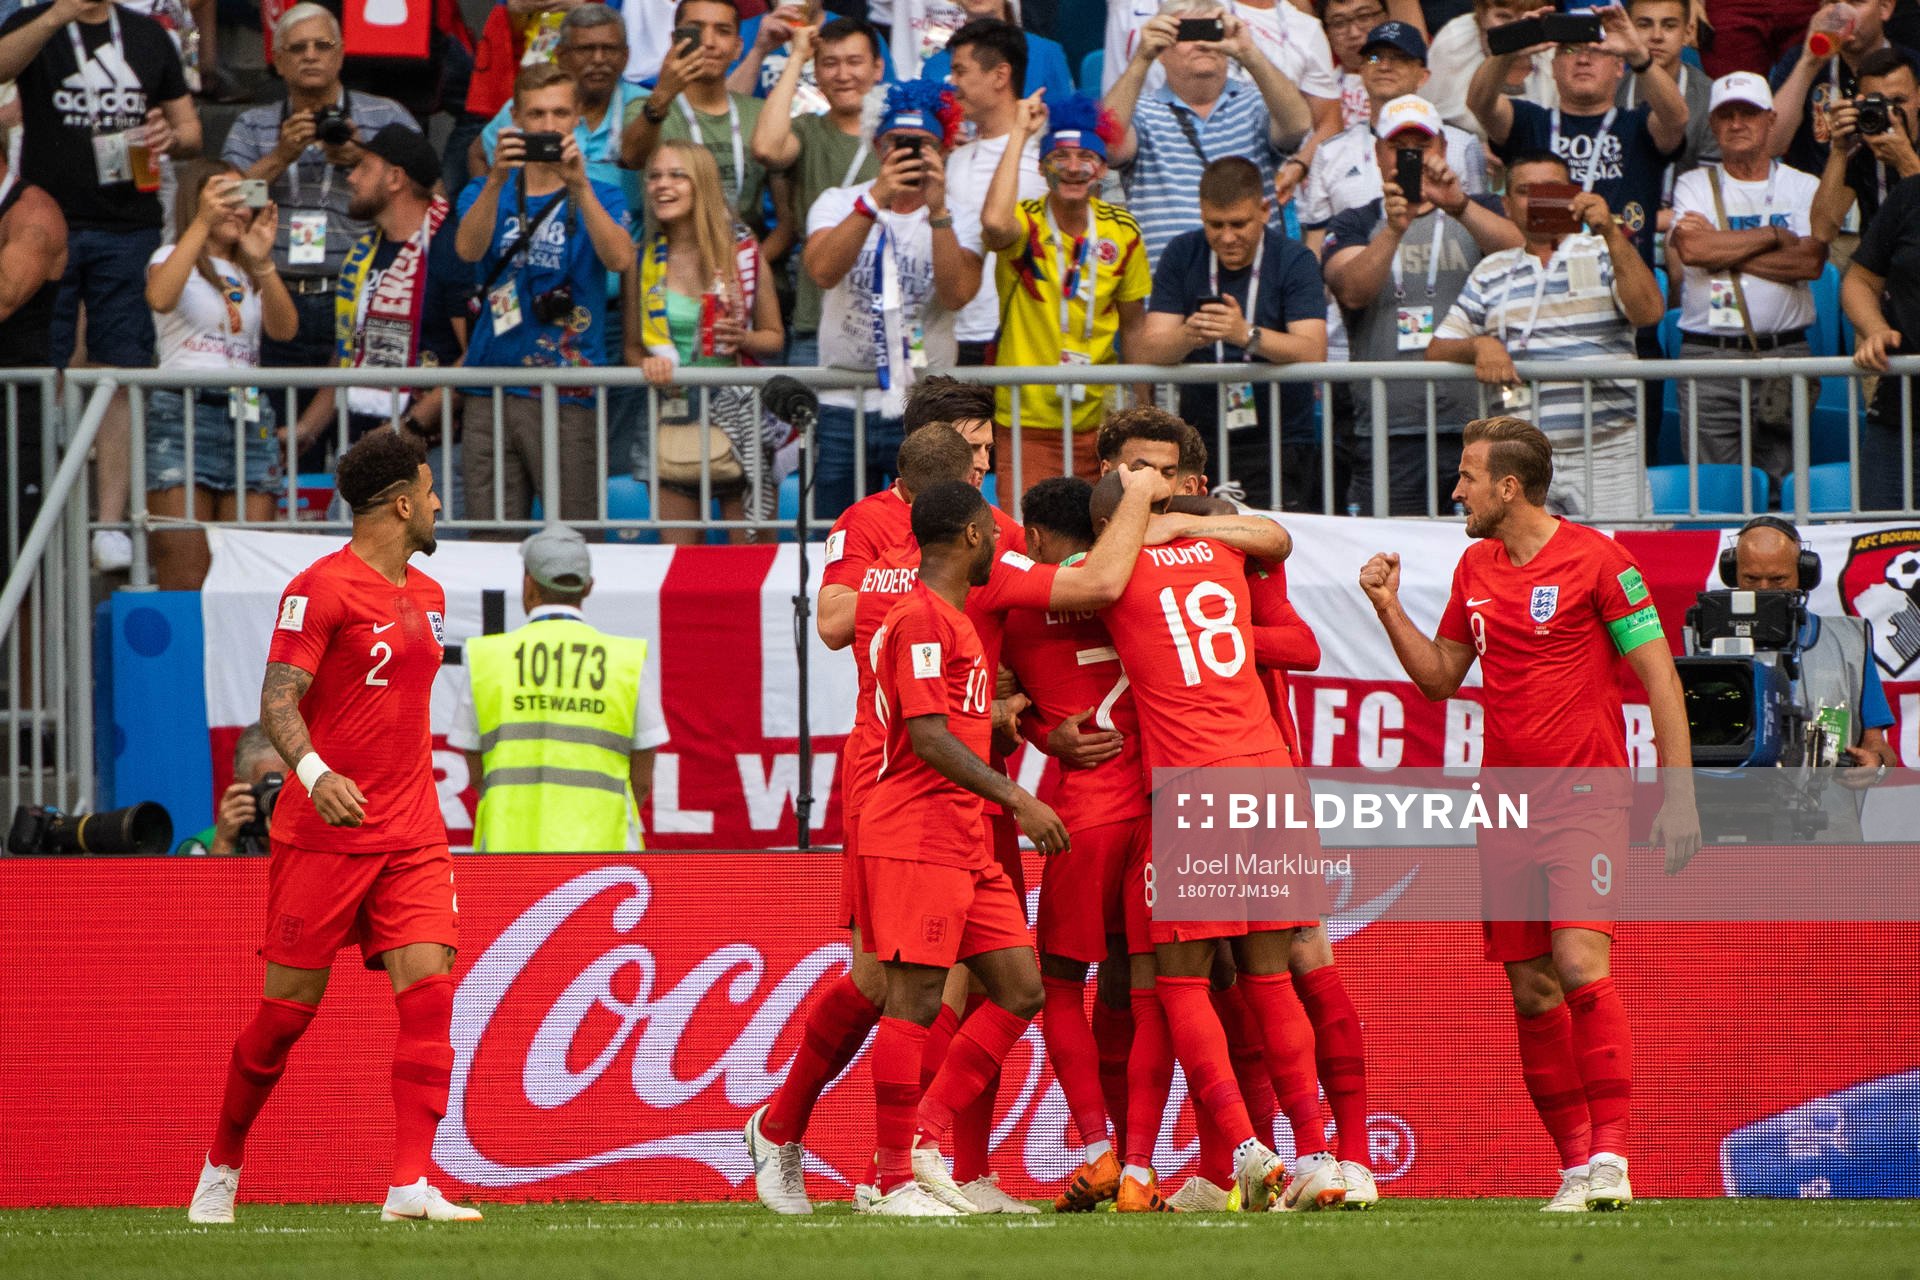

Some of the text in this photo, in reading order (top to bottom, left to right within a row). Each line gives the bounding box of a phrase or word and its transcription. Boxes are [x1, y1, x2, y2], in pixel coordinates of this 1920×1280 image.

[1144, 541, 1214, 567] YOUNG
[1855, 534, 1879, 550] AFC
[860, 567, 918, 593] ENDERS
[1159, 581, 1246, 687] 18
[1471, 611, 1487, 656] 9
[1727, 620, 1760, 628] SONY
[366, 641, 392, 686] 2
[514, 641, 606, 691] 10173
[513, 695, 605, 715] STEWARD
[963, 668, 988, 714] 10
[1289, 685, 1404, 773] FC
[1592, 852, 1613, 897] 9
